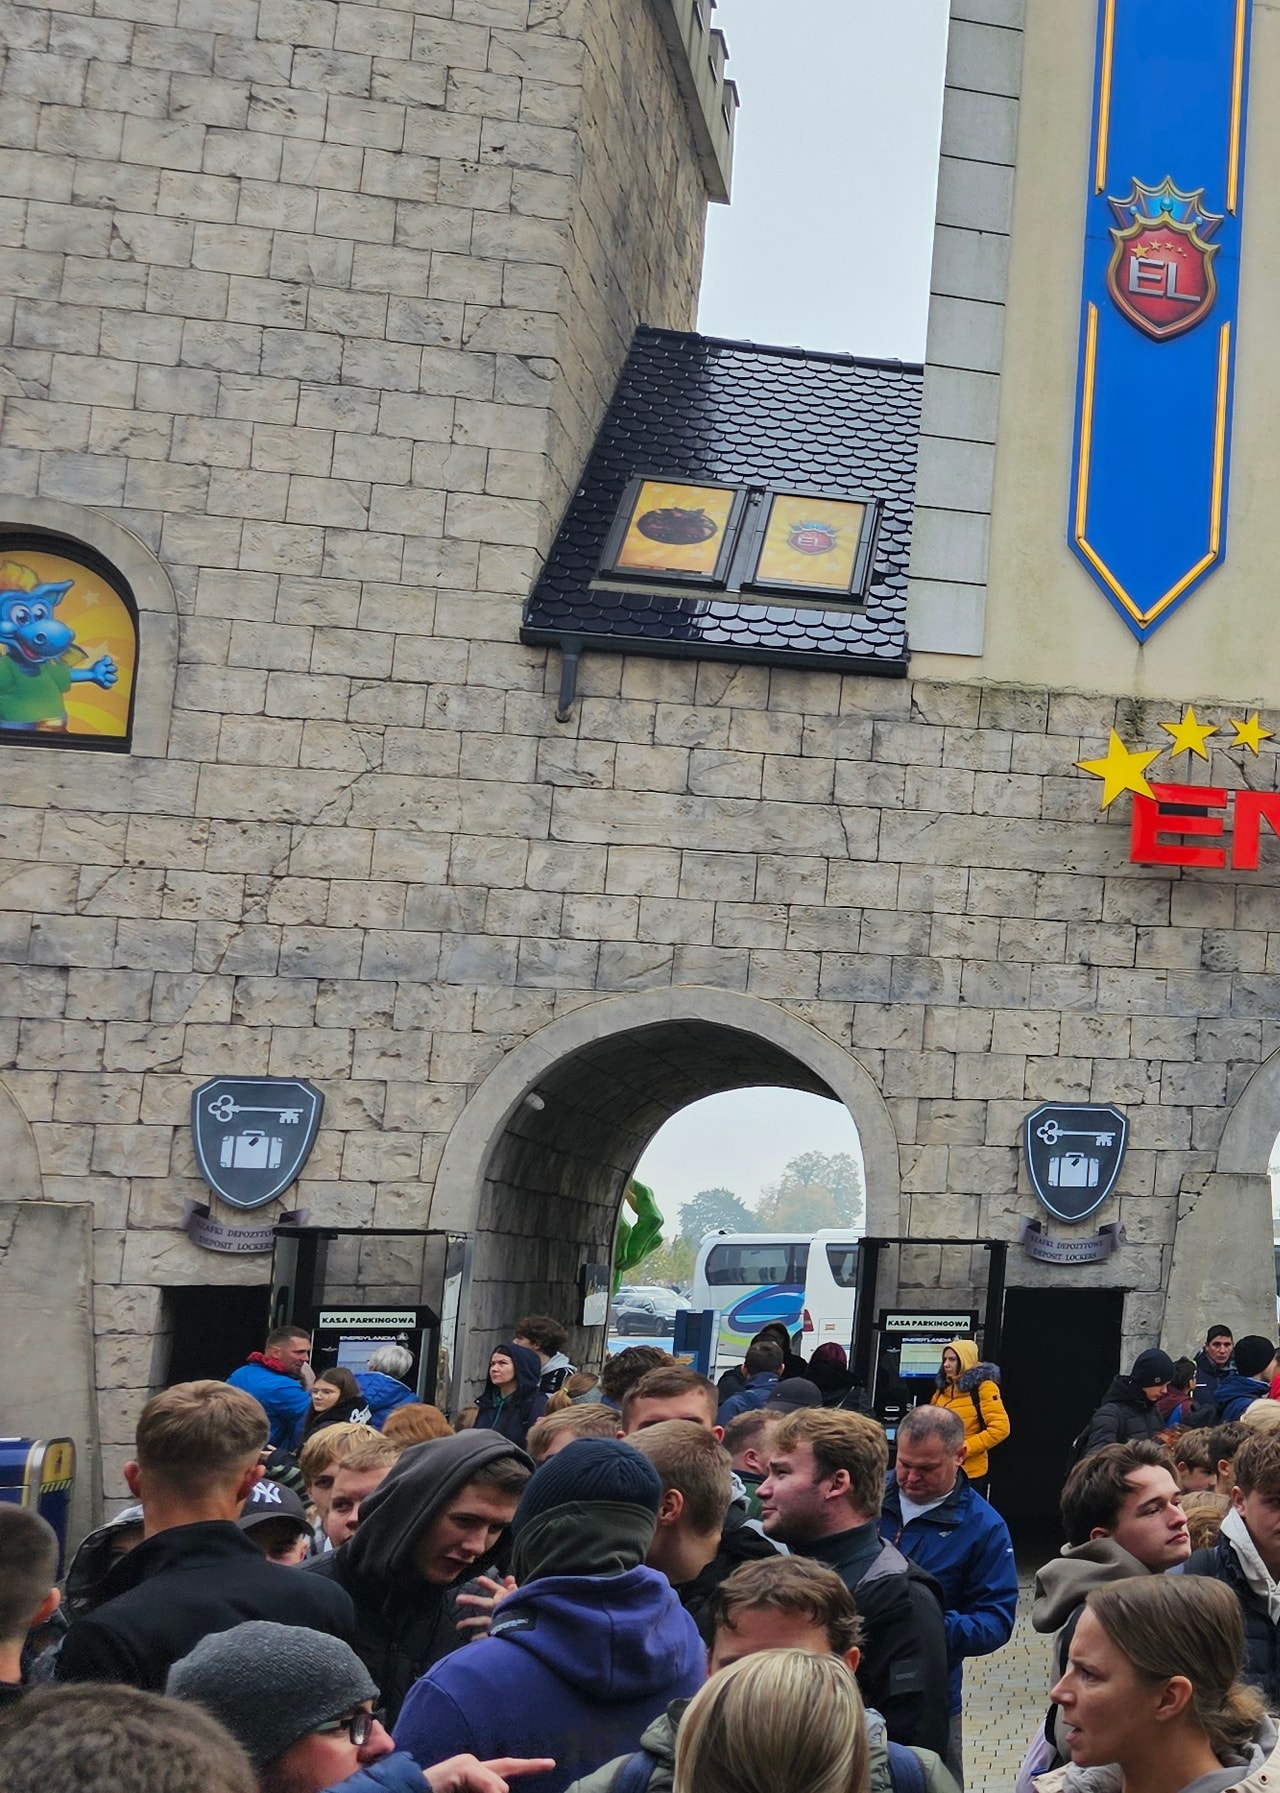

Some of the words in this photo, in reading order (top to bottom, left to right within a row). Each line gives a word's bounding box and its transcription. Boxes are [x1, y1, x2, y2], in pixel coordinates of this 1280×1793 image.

[1128, 255, 1201, 302] EL
[227, 1229, 273, 1239] DEPOZYTO
[198, 1235, 232, 1250] DEPOSIT
[1033, 1247, 1062, 1260] DEPOSIT
[252, 1481, 283, 1504] NY
